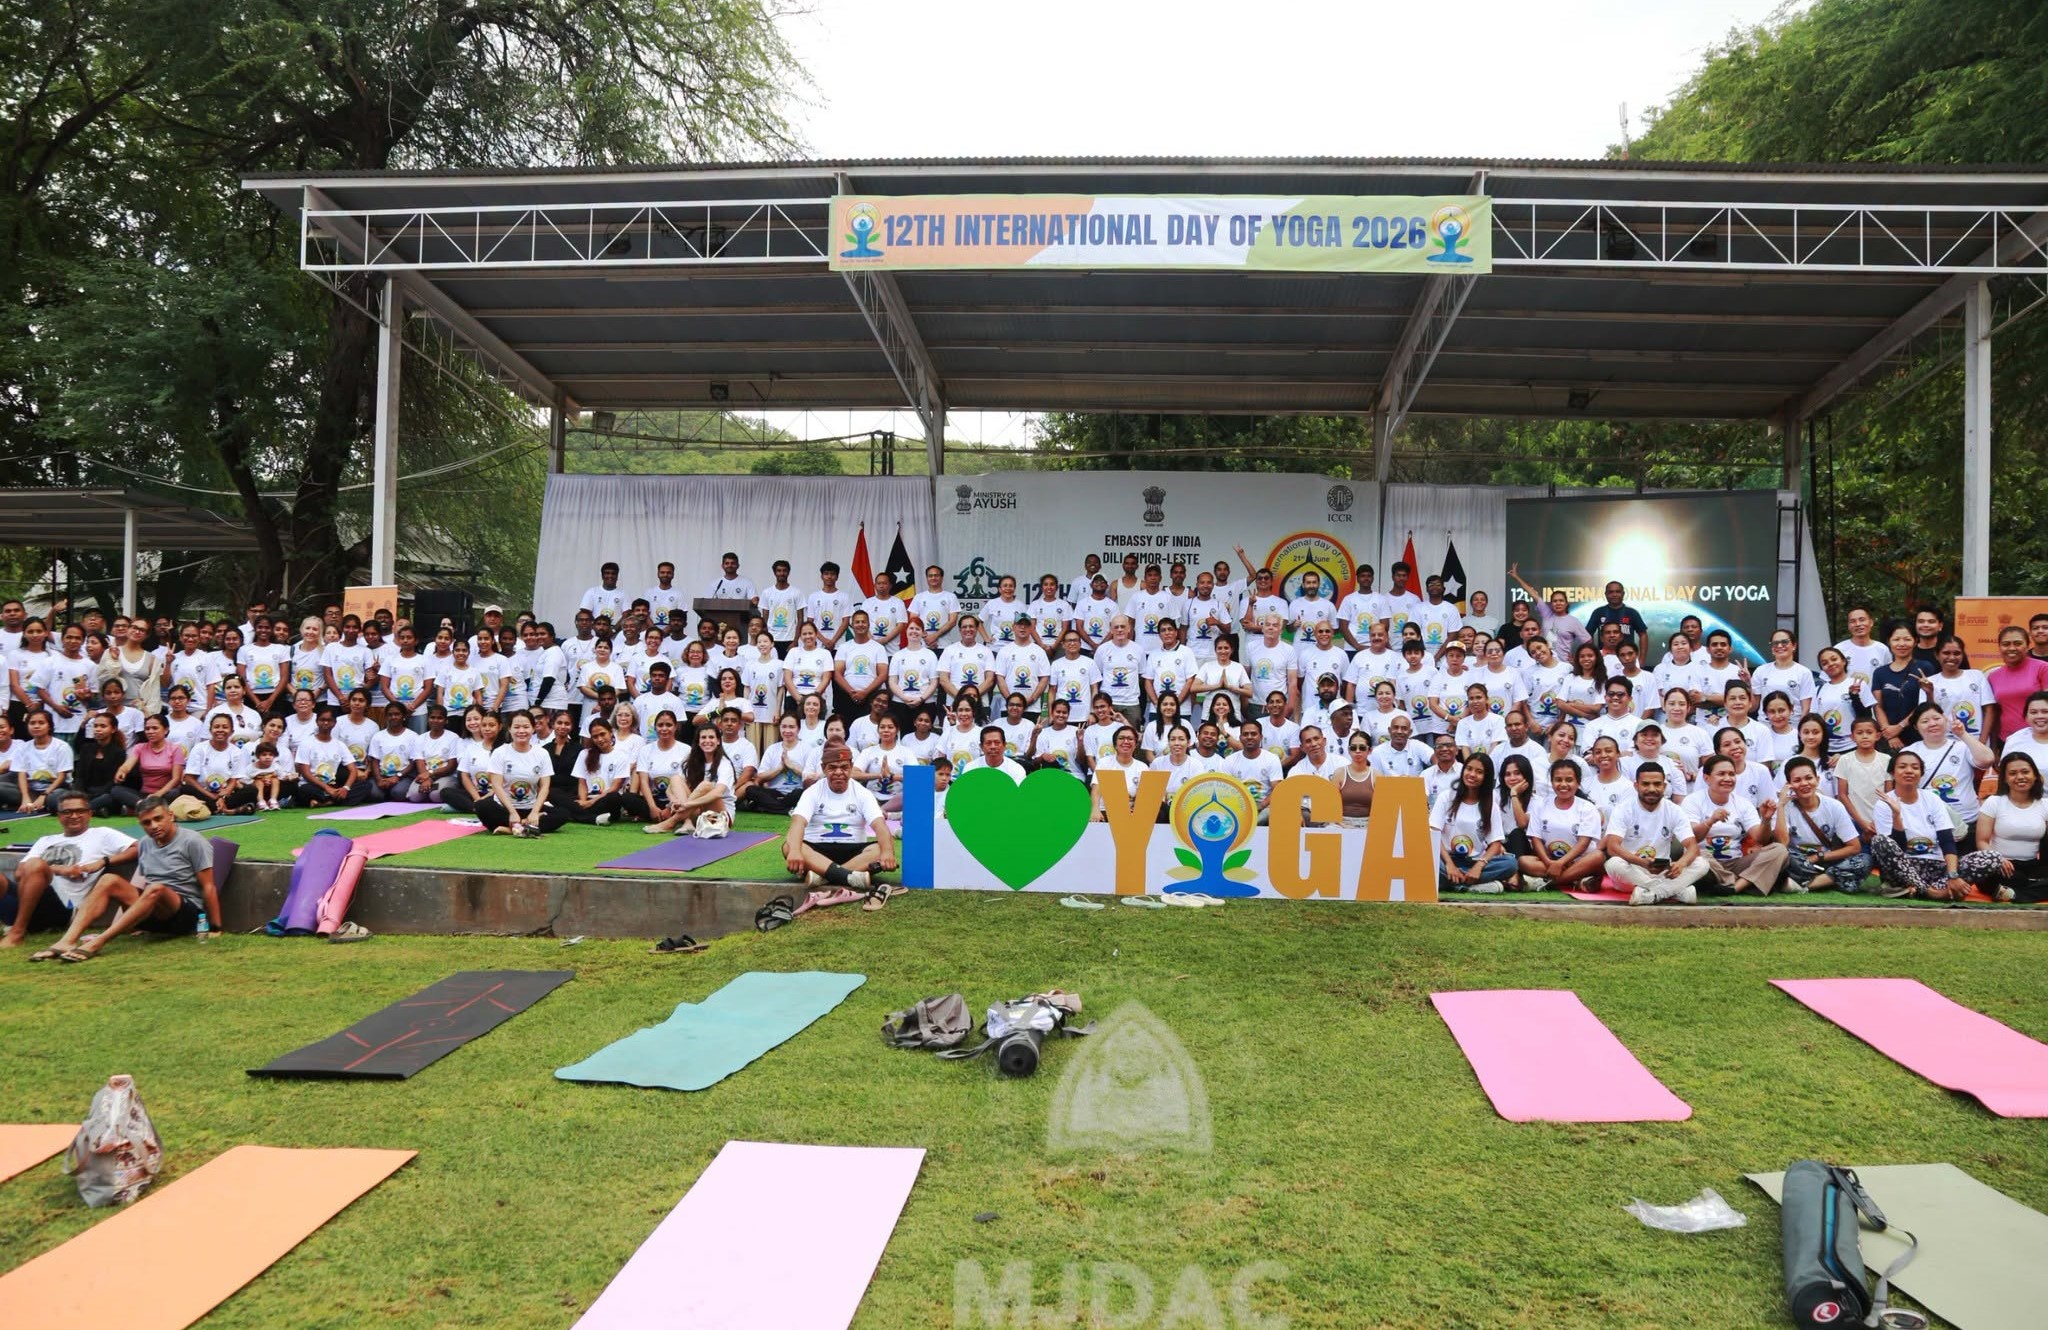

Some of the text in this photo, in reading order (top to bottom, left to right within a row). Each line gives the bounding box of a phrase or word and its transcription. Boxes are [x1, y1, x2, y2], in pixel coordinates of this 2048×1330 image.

[883, 214, 1426, 249] 12TH INTERNATIONAL DAY OF YOGA 2026
[973, 491, 1006, 499] MINISTRY
[973, 498, 1017, 509] AYUSH
[1327, 513, 1353, 522] ICCR
[1104, 534, 1201, 548] EMBASSY OF INDIA
[1272, 538, 1349, 581] nternational day of yoga
[1314, 555, 1330, 563] June
[1023, 583, 1072, 606] 12H
[1510, 587, 1534, 603] 12t
[1664, 585, 1697, 601] DAY
[1699, 585, 1721, 601] OF
[1725, 585, 1770, 601] YOGA
[960, 601, 980, 611] oga
[903, 765, 934, 889] I
